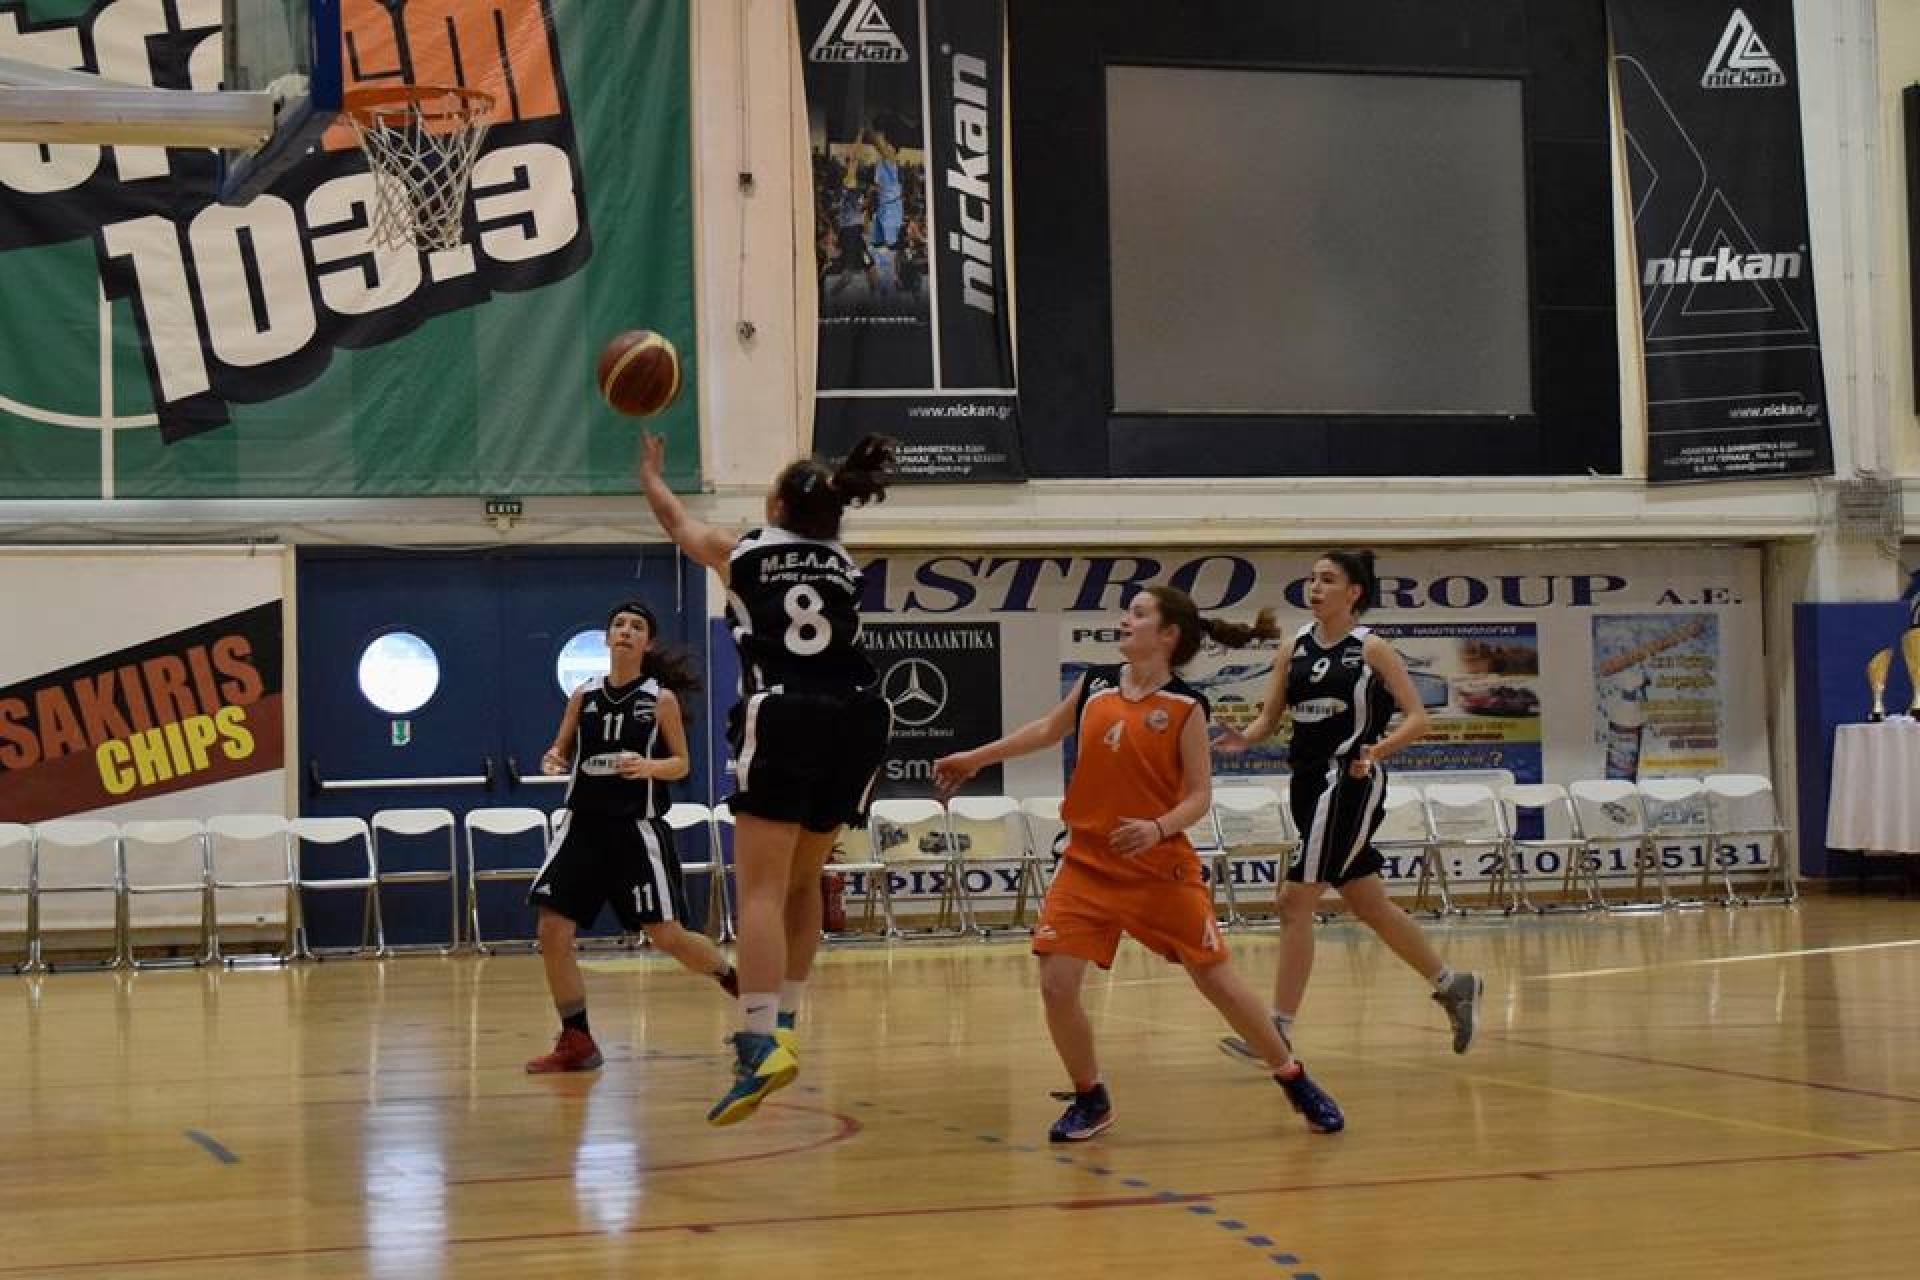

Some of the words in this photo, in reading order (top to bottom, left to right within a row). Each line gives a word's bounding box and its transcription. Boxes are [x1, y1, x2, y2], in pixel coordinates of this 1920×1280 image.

[814, 42, 903, 62] nickan
[1706, 68, 1782, 87] nickan
[948, 52, 995, 316] nickan
[102, 142, 578, 403] 103.3
[1644, 247, 1801, 285] nickan
[783, 583, 832, 656] 8
[1309, 656, 1331, 684] 9
[0, 634, 264, 769] SAKIRIS
[602, 712, 625, 742] 11
[1103, 719, 1126, 752] 4
[96, 705, 255, 795] CHIPS
[886, 759, 932, 780] sm
[1477, 850, 1561, 875] 210
[631, 882, 653, 914] 11
